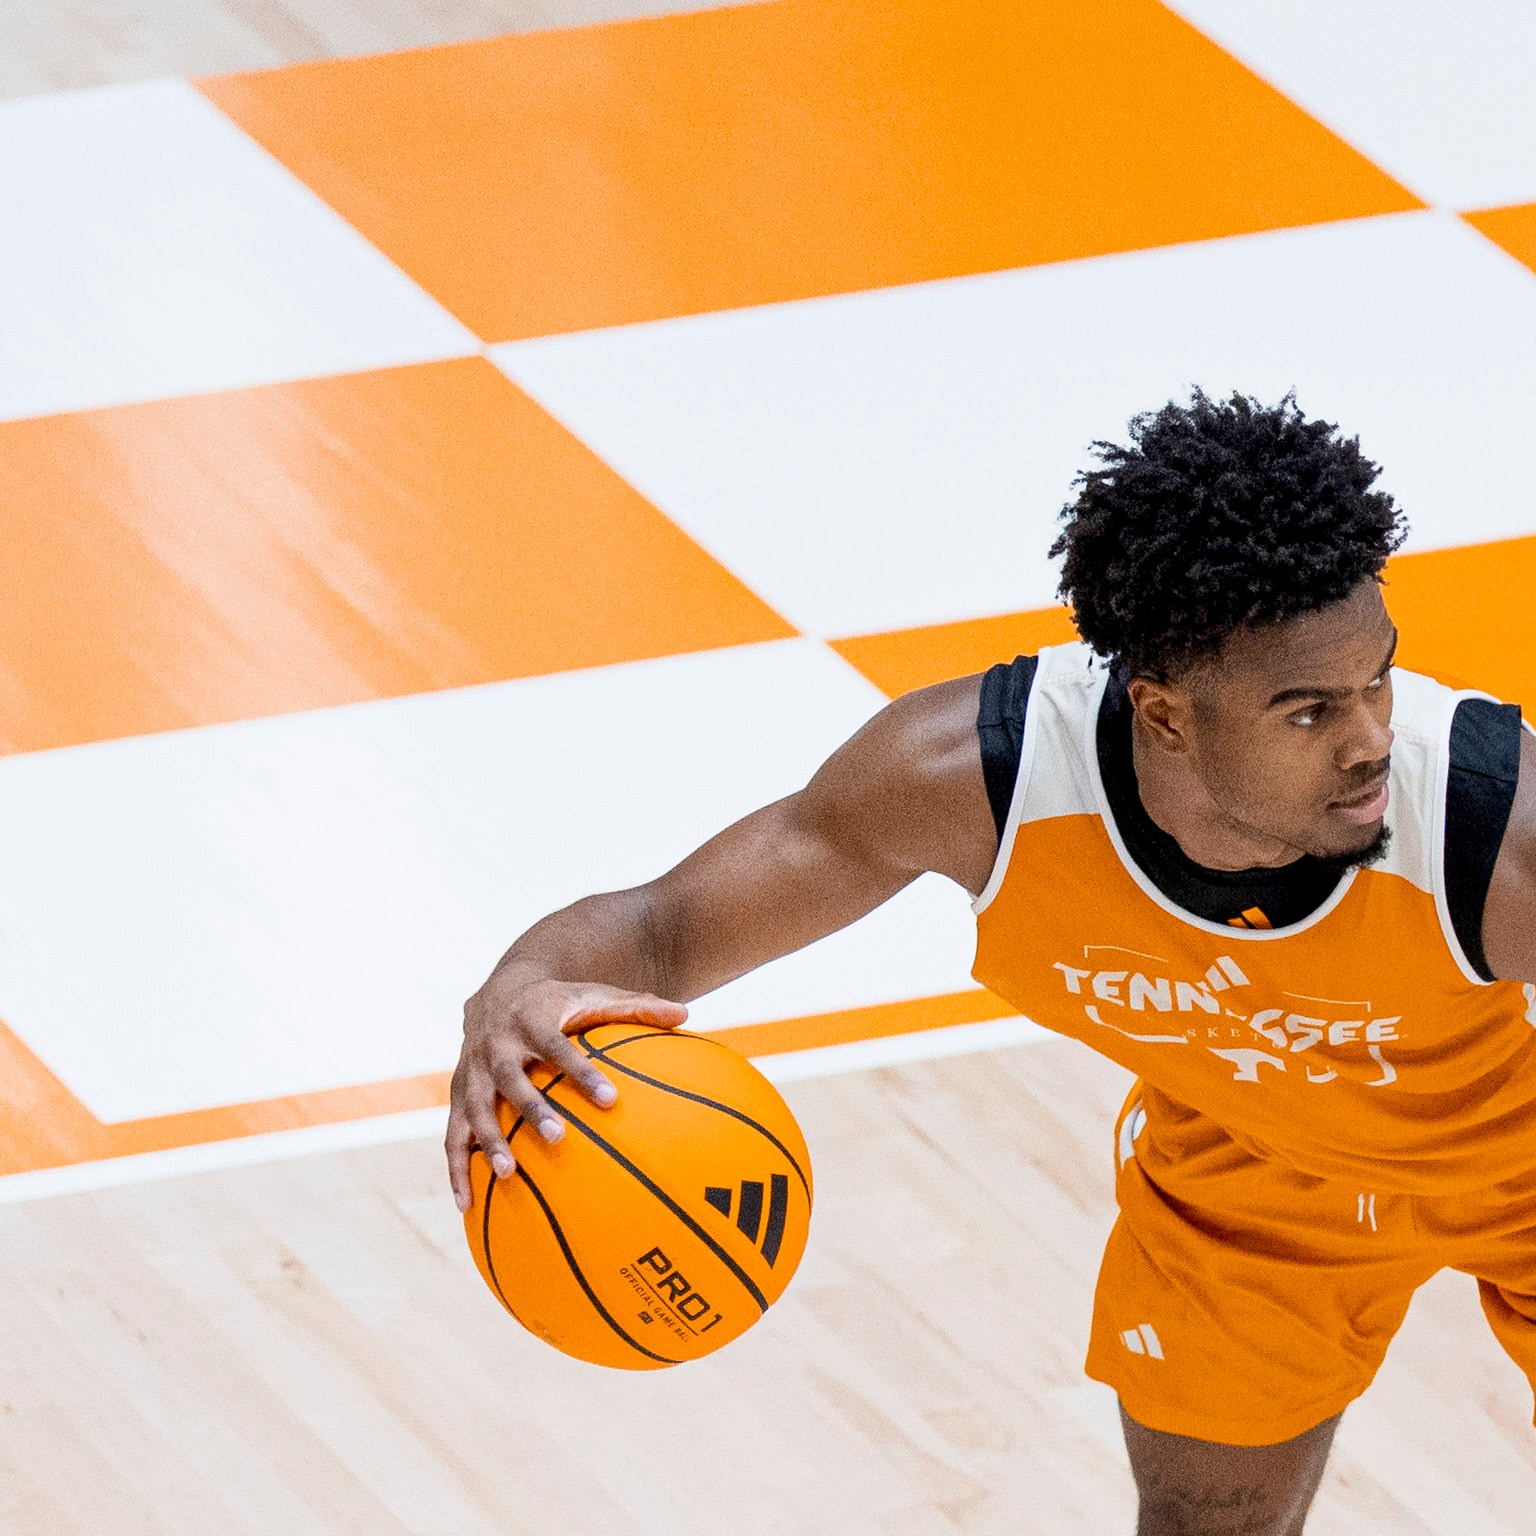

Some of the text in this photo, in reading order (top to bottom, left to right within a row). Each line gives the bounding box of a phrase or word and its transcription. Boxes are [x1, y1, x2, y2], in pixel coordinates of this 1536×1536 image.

[1052, 961, 1402, 1053] TENNSSEE
[620, 1267, 654, 1307] OFFICIAL
[653, 1307, 676, 1329] GAME
